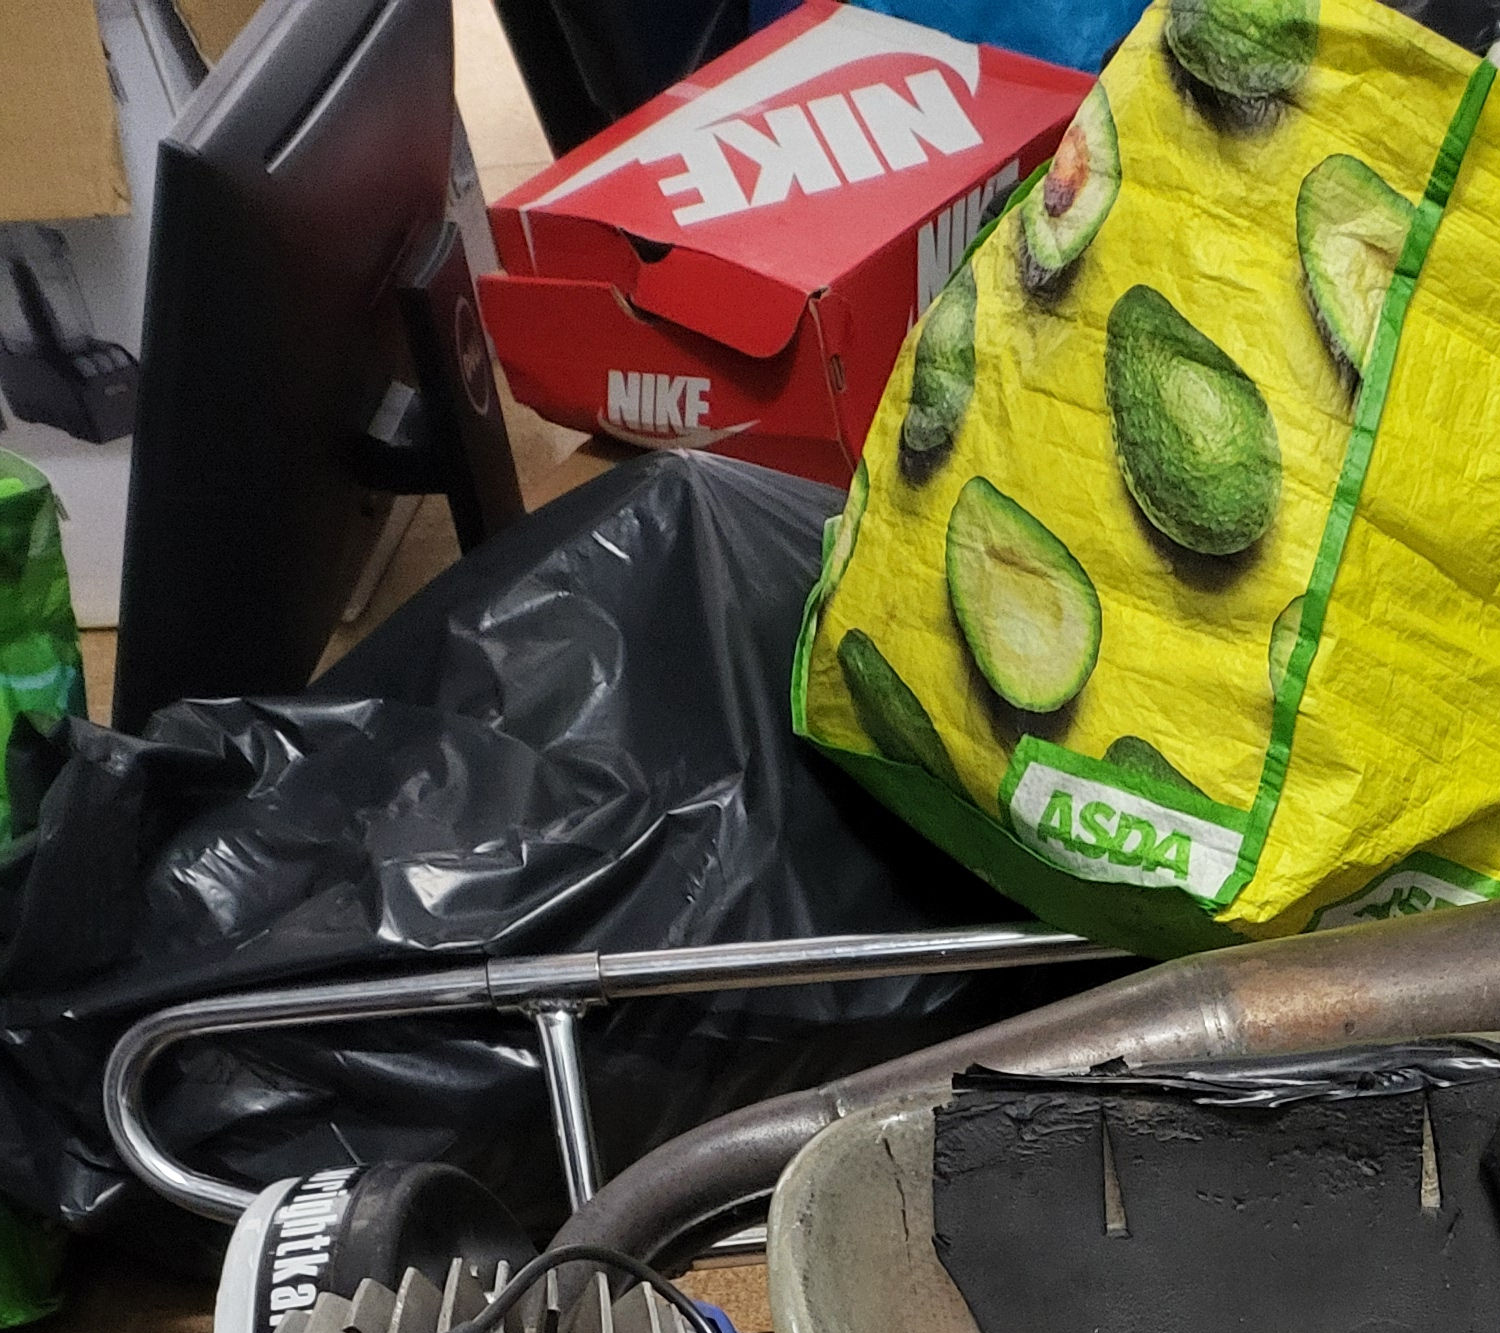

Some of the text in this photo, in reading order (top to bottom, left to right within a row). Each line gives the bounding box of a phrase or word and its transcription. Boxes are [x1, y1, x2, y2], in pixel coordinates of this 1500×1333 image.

[658, 69, 983, 228] NIKE
[606, 369, 711, 433] NIKE
[1036, 790, 1192, 881] ASDA
